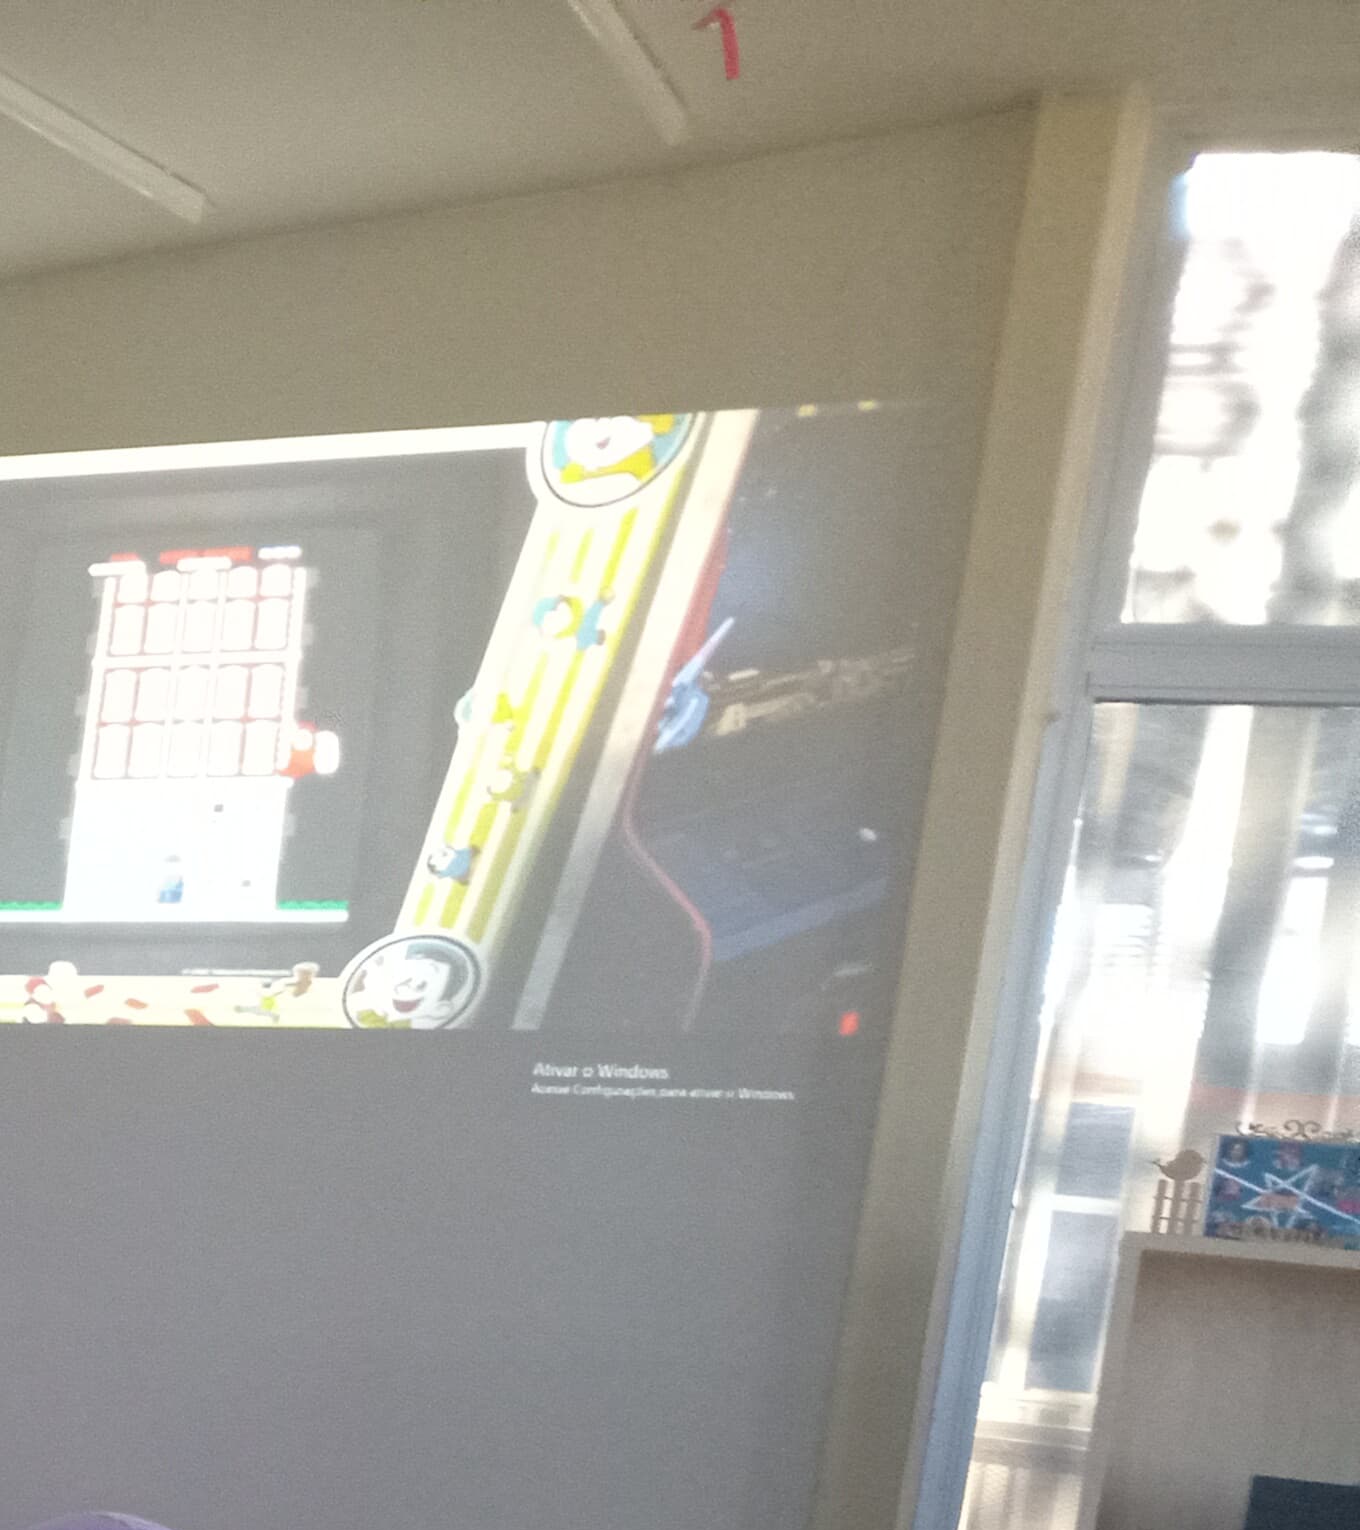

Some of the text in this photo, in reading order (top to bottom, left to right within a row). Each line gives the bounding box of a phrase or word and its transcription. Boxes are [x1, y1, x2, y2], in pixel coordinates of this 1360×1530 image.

[533, 1062, 669, 1079] Ativar o Windows
